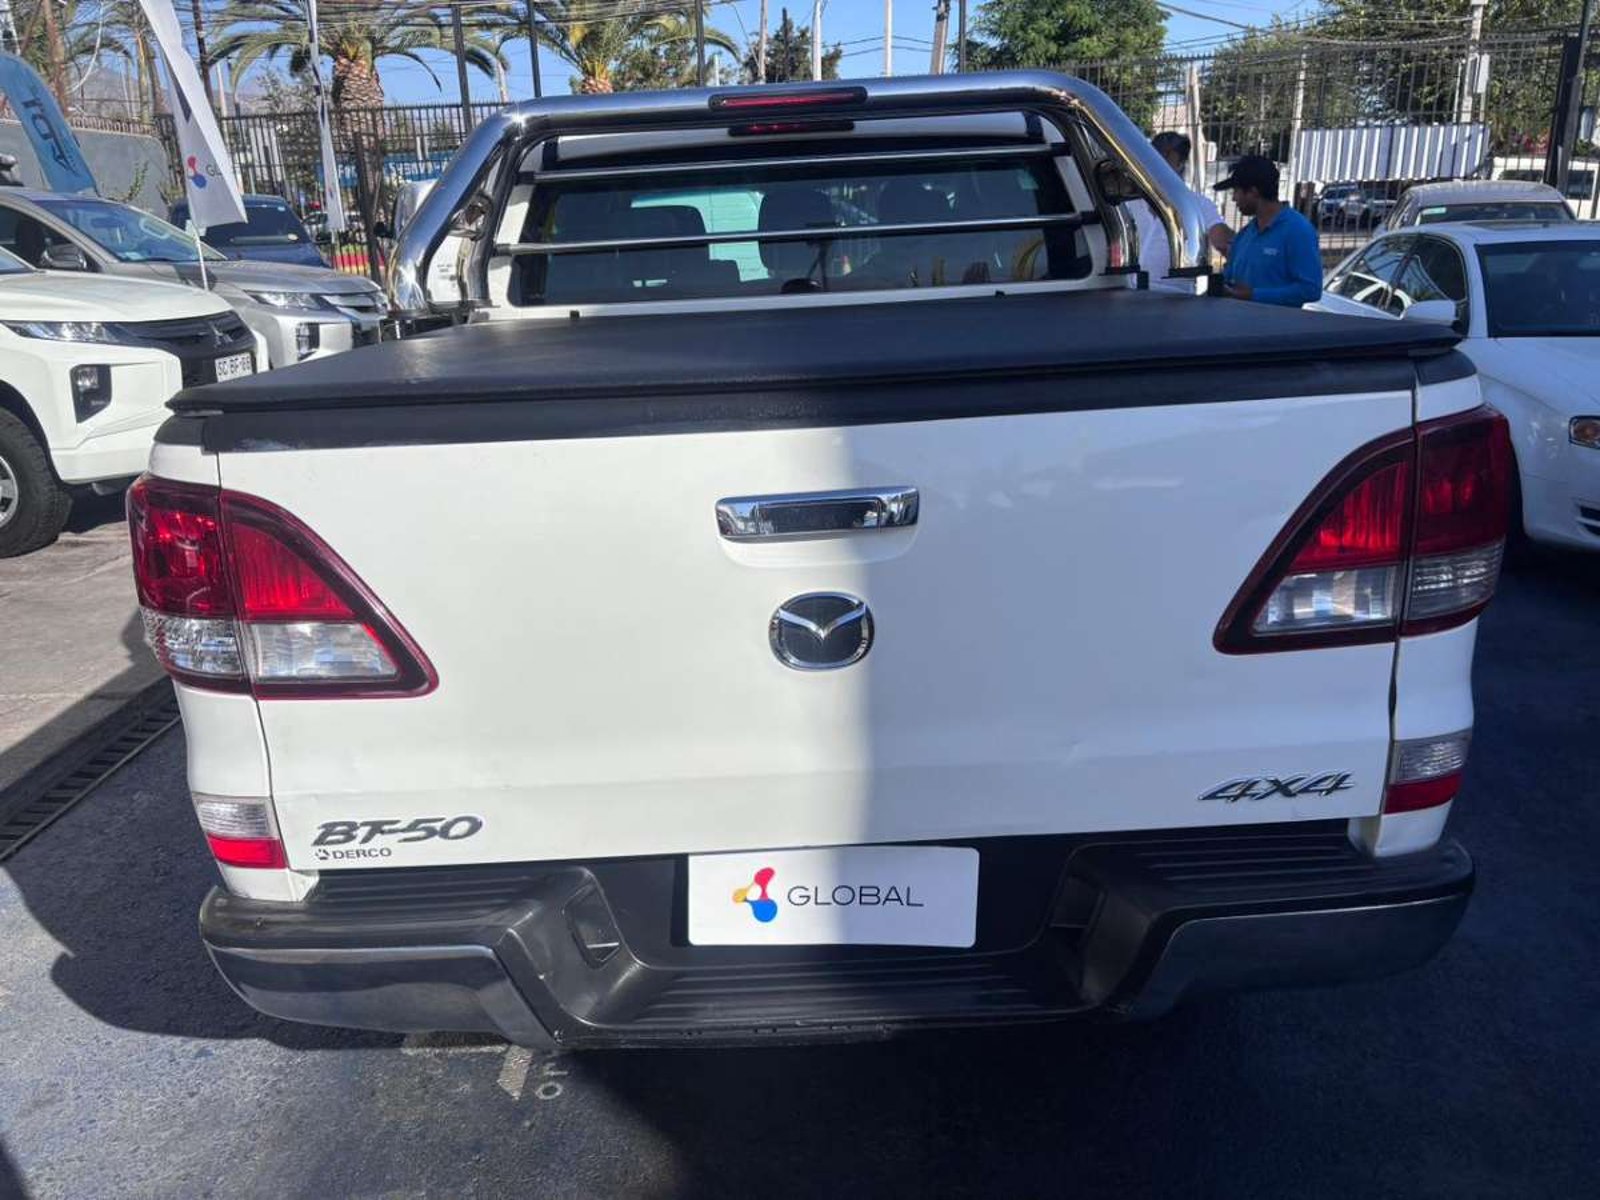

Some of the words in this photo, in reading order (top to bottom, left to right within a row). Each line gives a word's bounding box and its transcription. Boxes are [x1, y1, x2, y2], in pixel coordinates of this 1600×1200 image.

[311, 816, 483, 847] BT-50
[332, 848, 392, 860] DERCO
[787, 885, 924, 907] GLOBAL
